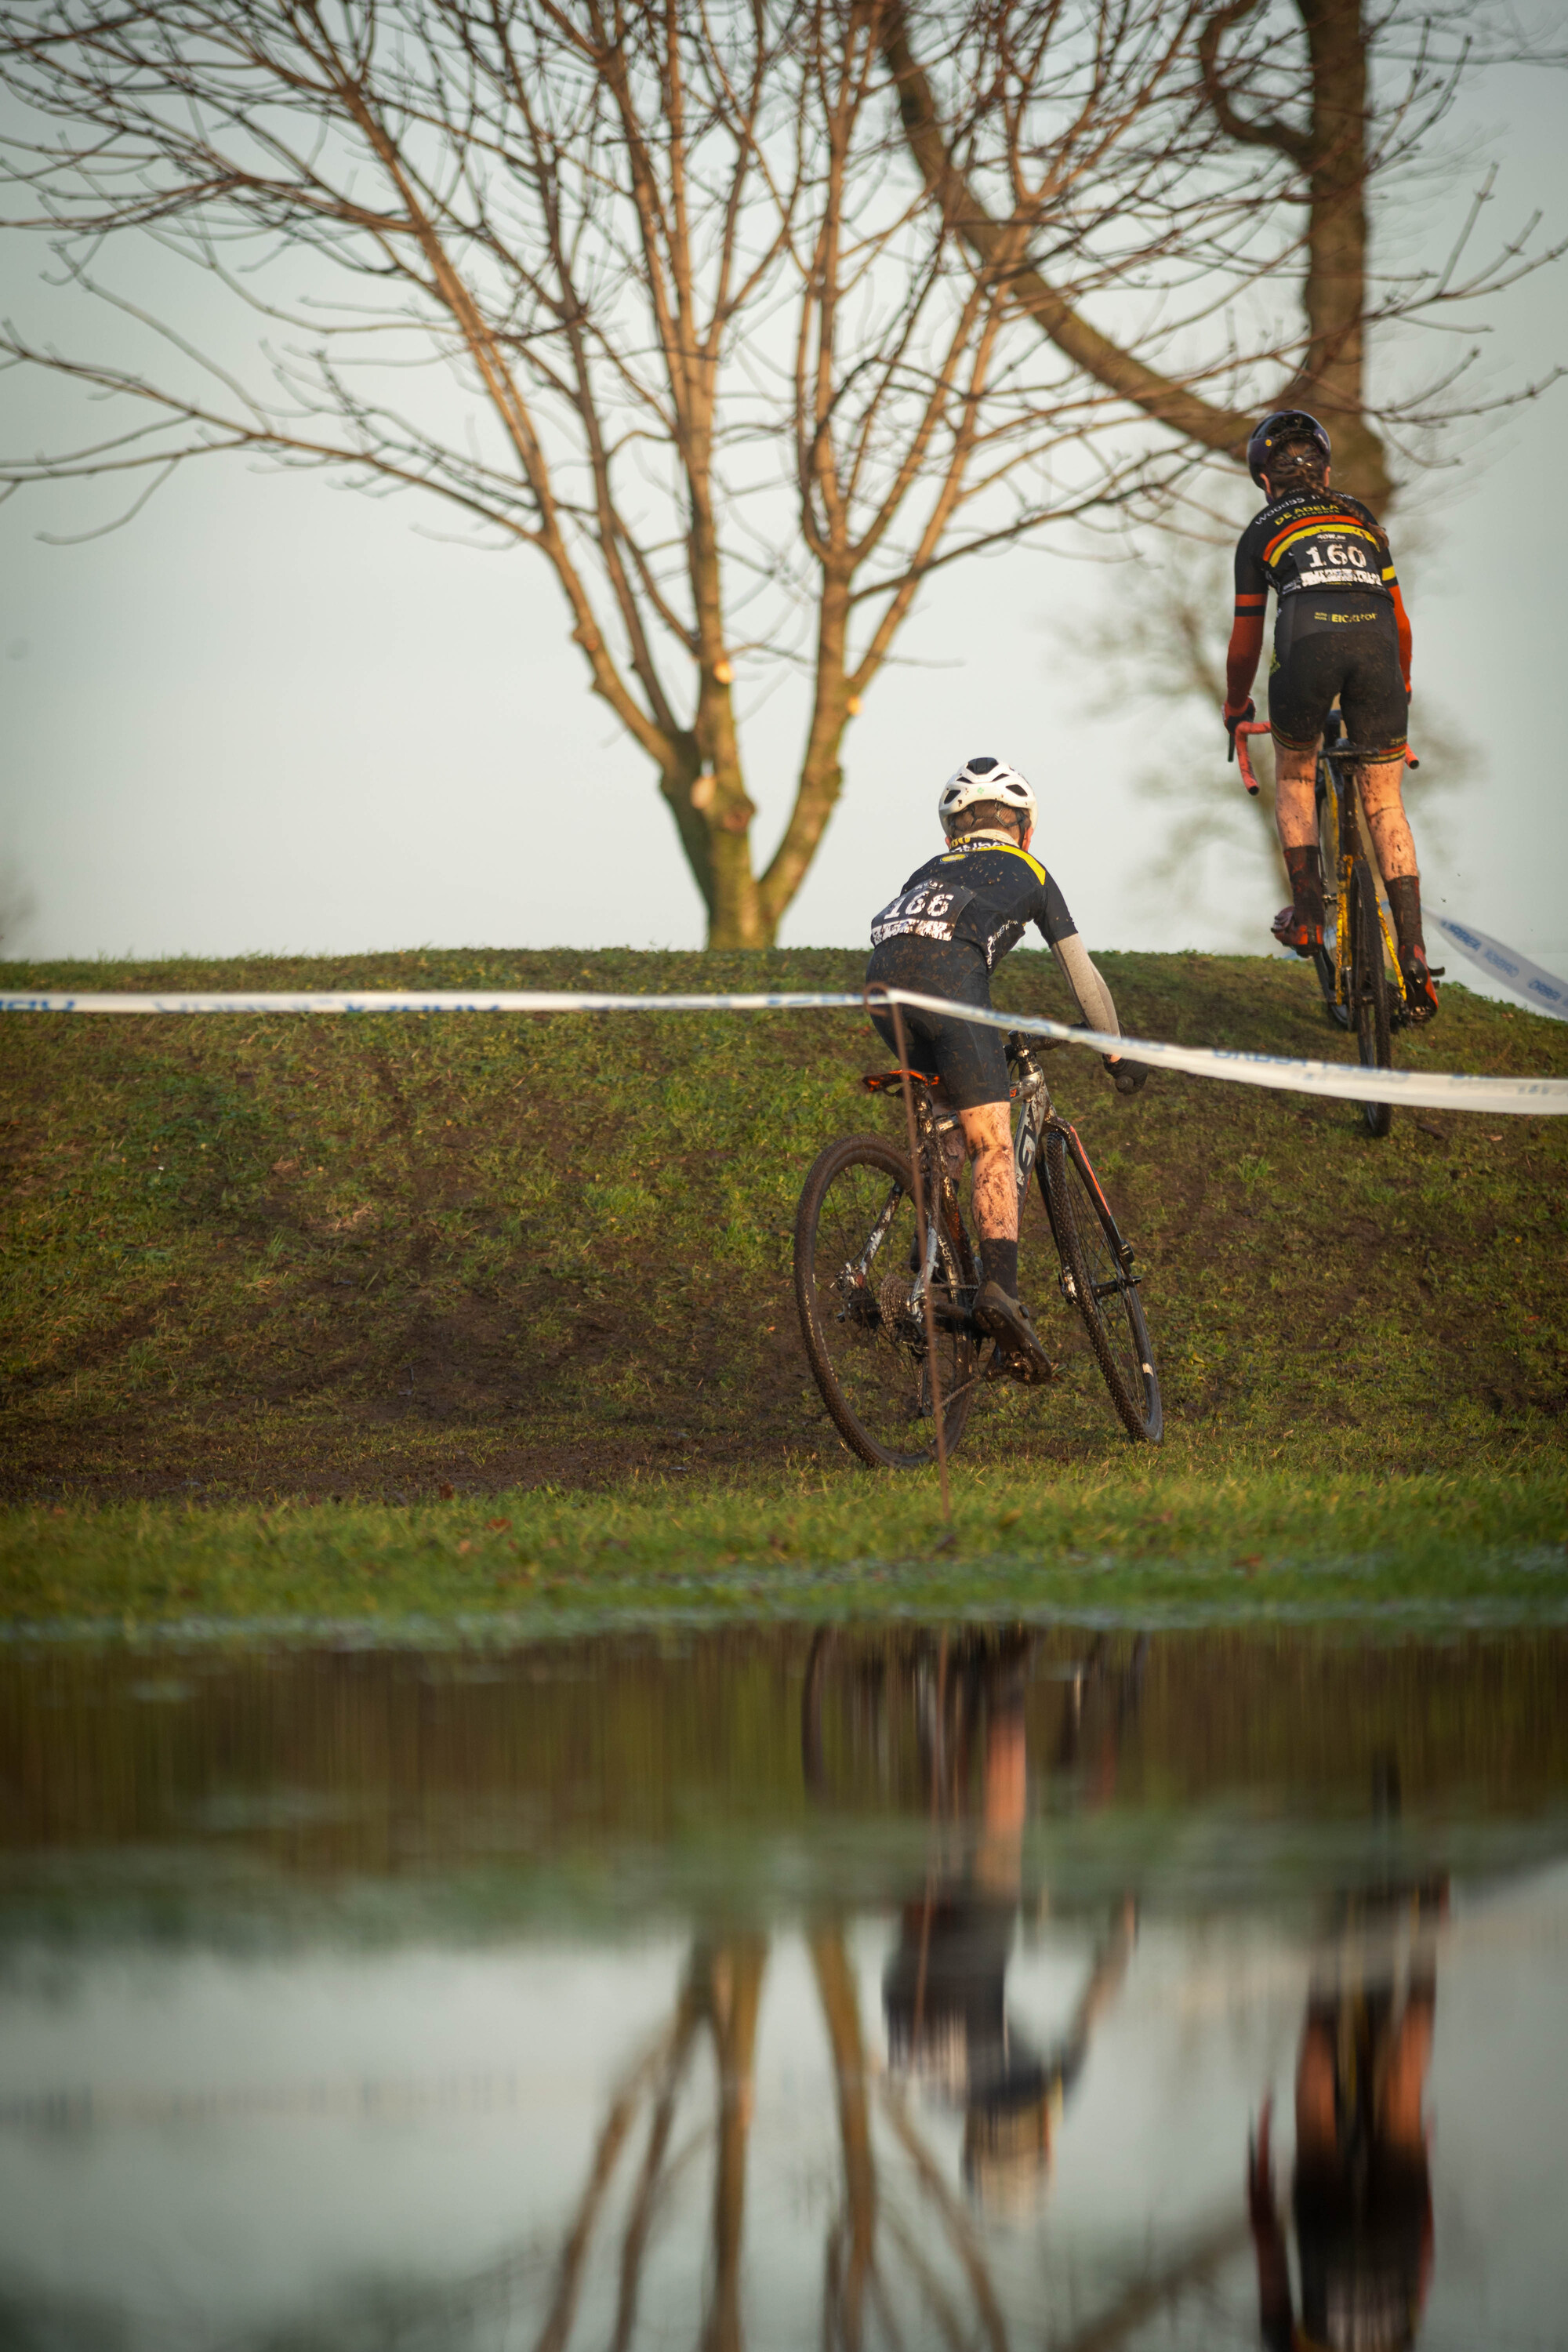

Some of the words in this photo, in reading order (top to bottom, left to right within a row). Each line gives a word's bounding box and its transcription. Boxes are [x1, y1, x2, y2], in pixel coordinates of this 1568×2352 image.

[1274, 512, 1292, 525] DE
[1294, 504, 1339, 514] ADELA
[1305, 544, 1367, 568] 160
[884, 891, 954, 919] 166
